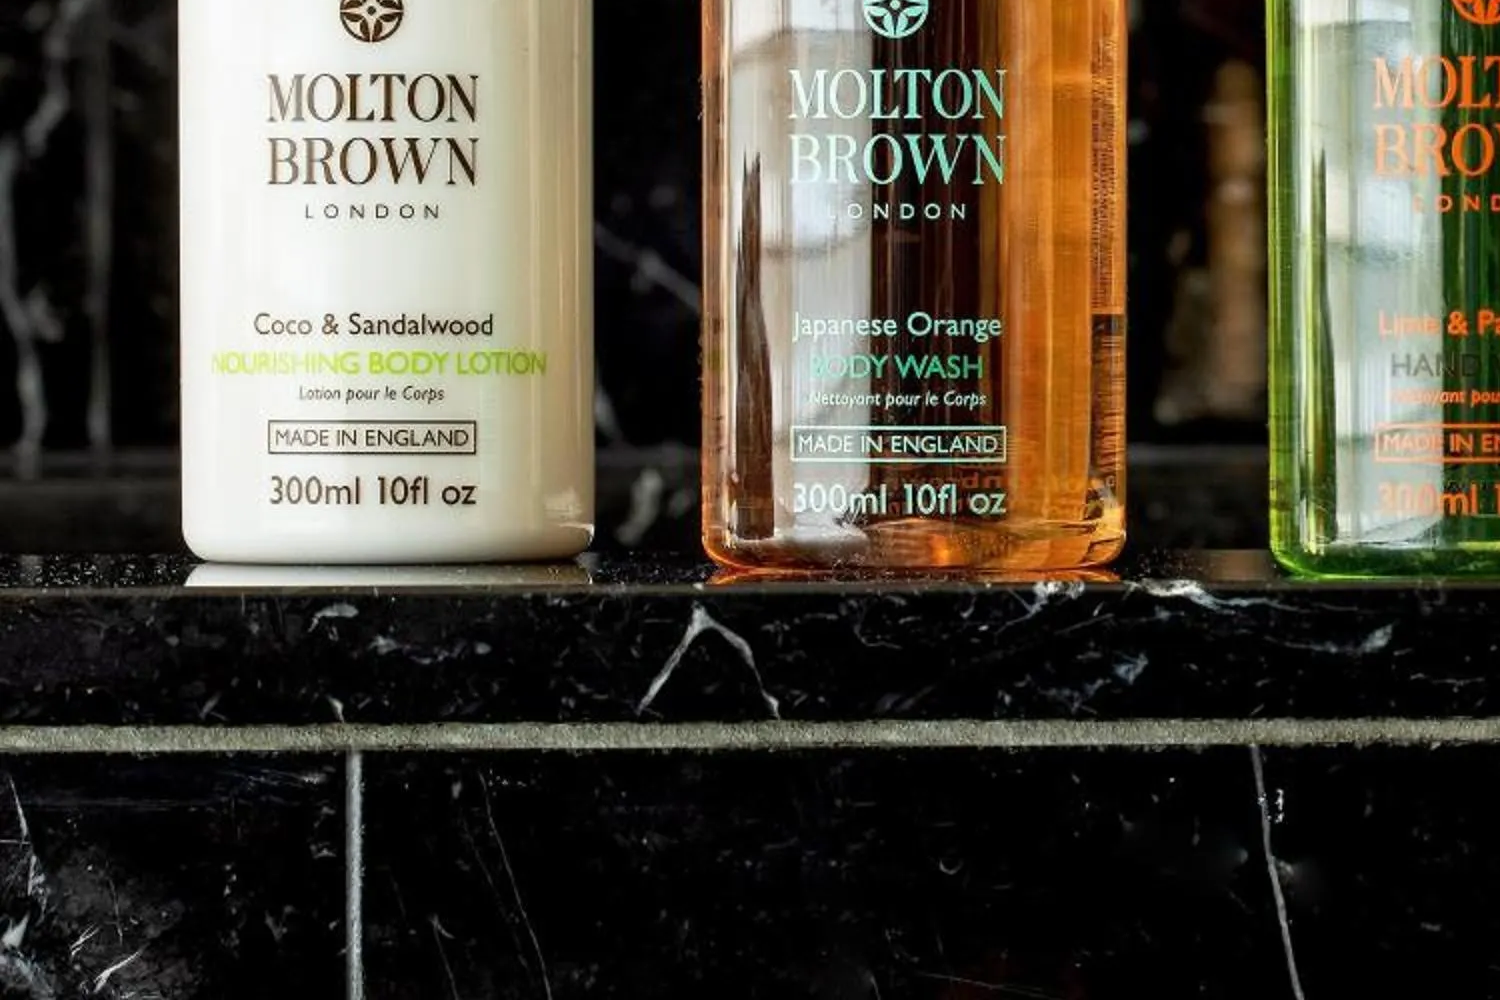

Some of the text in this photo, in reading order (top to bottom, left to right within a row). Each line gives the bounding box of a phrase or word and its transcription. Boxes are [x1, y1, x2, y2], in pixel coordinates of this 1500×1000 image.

[267, 73, 480, 123] MOLTON
[789, 69, 1007, 120] MOLTON
[267, 137, 480, 186] BROWN
[789, 133, 1007, 185] BROWN
[305, 203, 440, 220] LONDON
[826, 203, 966, 220] LONDON
[253, 313, 494, 336] Coco & Sandalwood
[792, 312, 1001, 342] Japanese Orange
[1379, 311, 1440, 336] Lime
[1448, 311, 1469, 336] &
[211, 351, 547, 375] NOURISHING BODY LOTION
[811, 355, 984, 379] BODY WASH
[1391, 353, 1480, 377] HAND
[299, 386, 445, 404] Lotion pour le Corps
[810, 391, 986, 410] Nettoyant pour le Corps
[275, 429, 469, 446] MADE IN ENGLAND
[799, 435, 998, 453] MADE IN ENGLAND
[1383, 434, 1442, 453] MADE
[1451, 433, 1473, 452] IN
[269, 475, 477, 505] 300ml 10fl oz
[793, 483, 1006, 514] 300ml 10fl oz
